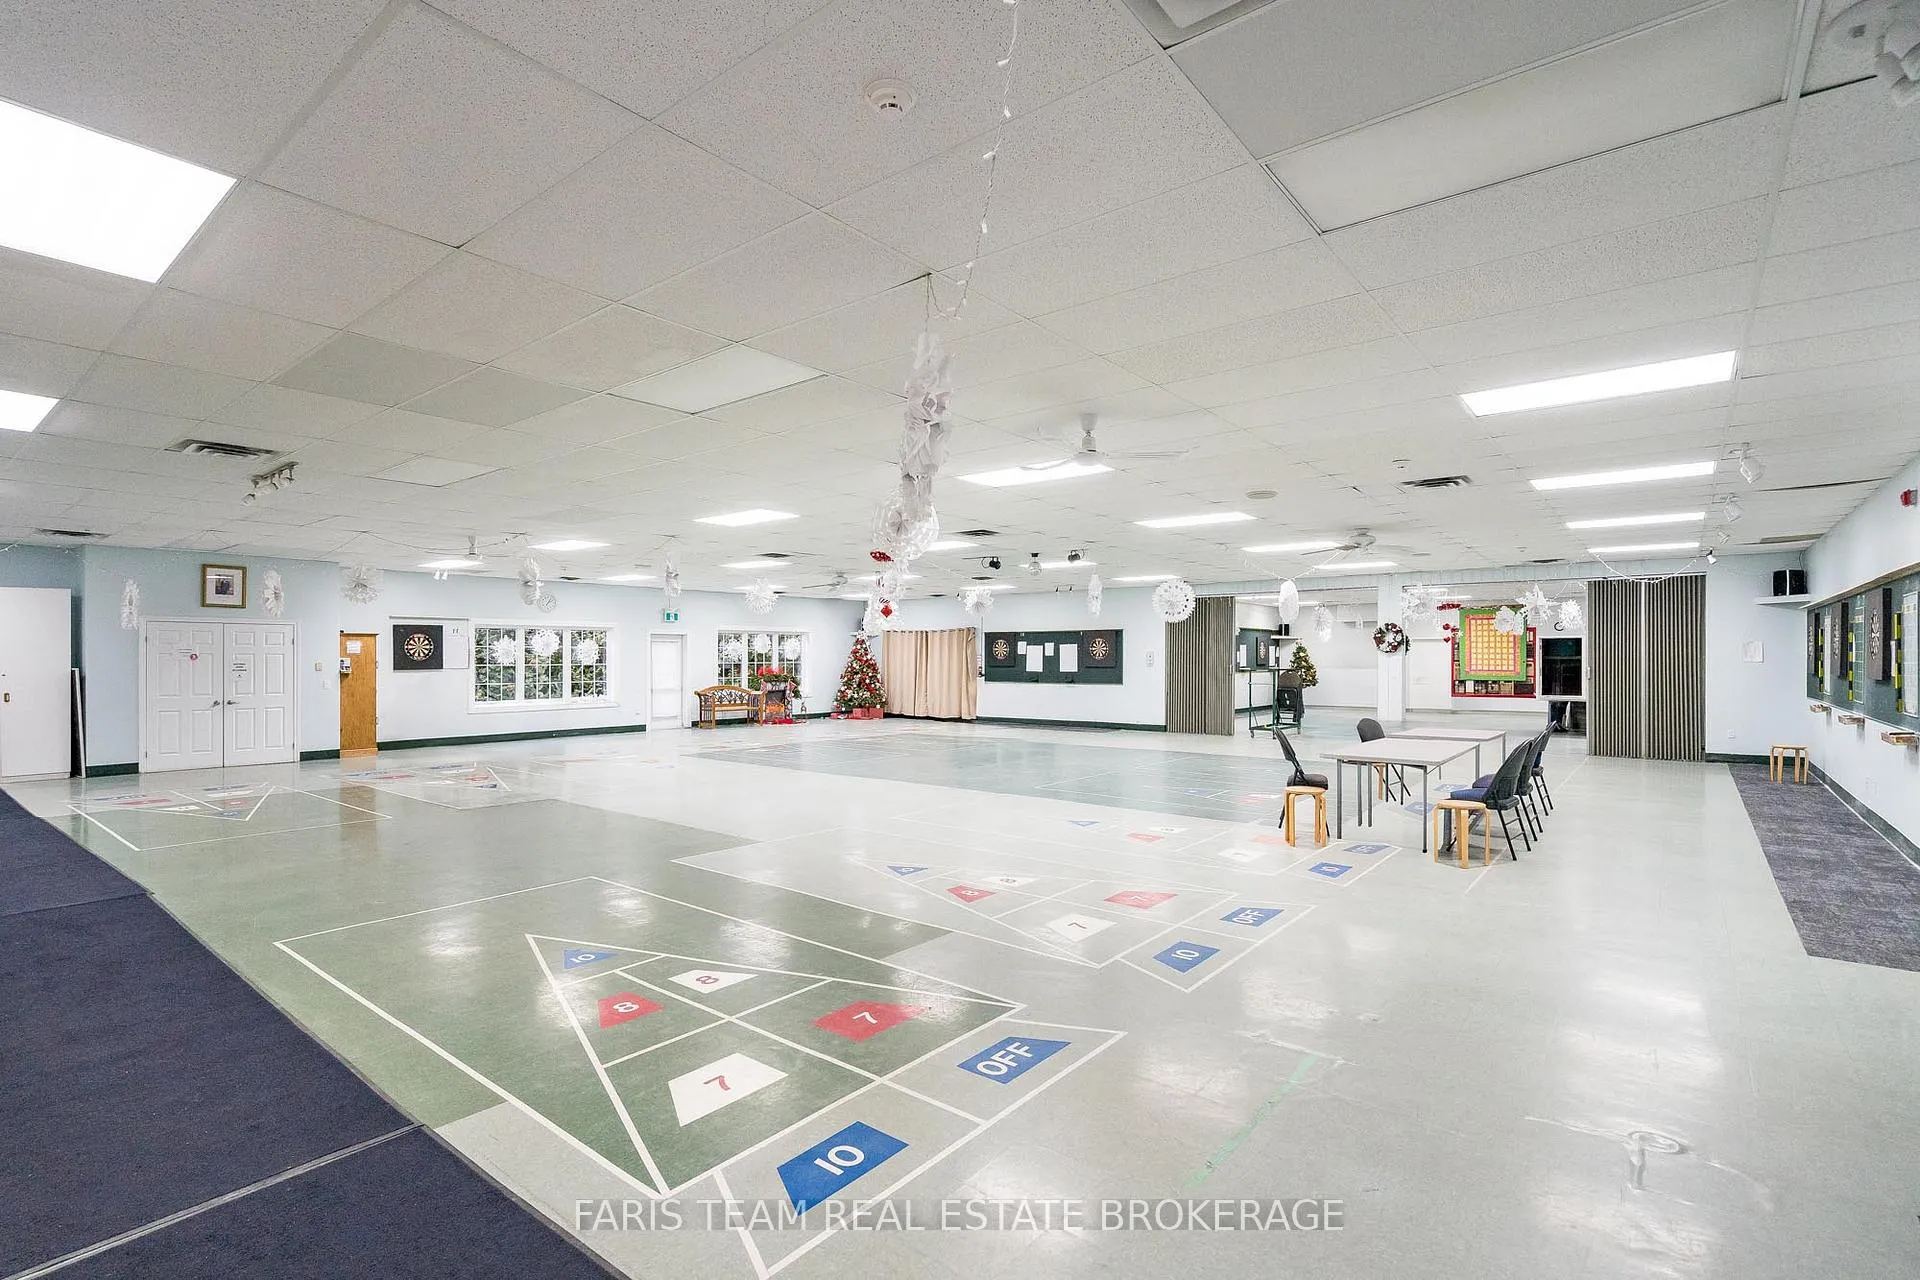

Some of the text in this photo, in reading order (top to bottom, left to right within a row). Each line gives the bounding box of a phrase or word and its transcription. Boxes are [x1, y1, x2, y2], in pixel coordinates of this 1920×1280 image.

[1232, 909, 1265, 924] OFF
[571, 953, 595, 963] 10
[1172, 949, 1200, 961] 10
[695, 975, 719, 985] 8
[613, 1001, 639, 1013] 8
[852, 1011, 878, 1024] 7
[976, 1041, 1034, 1076] OFF
[703, 1075, 731, 1091] 7
[814, 1145, 864, 1176] 10
